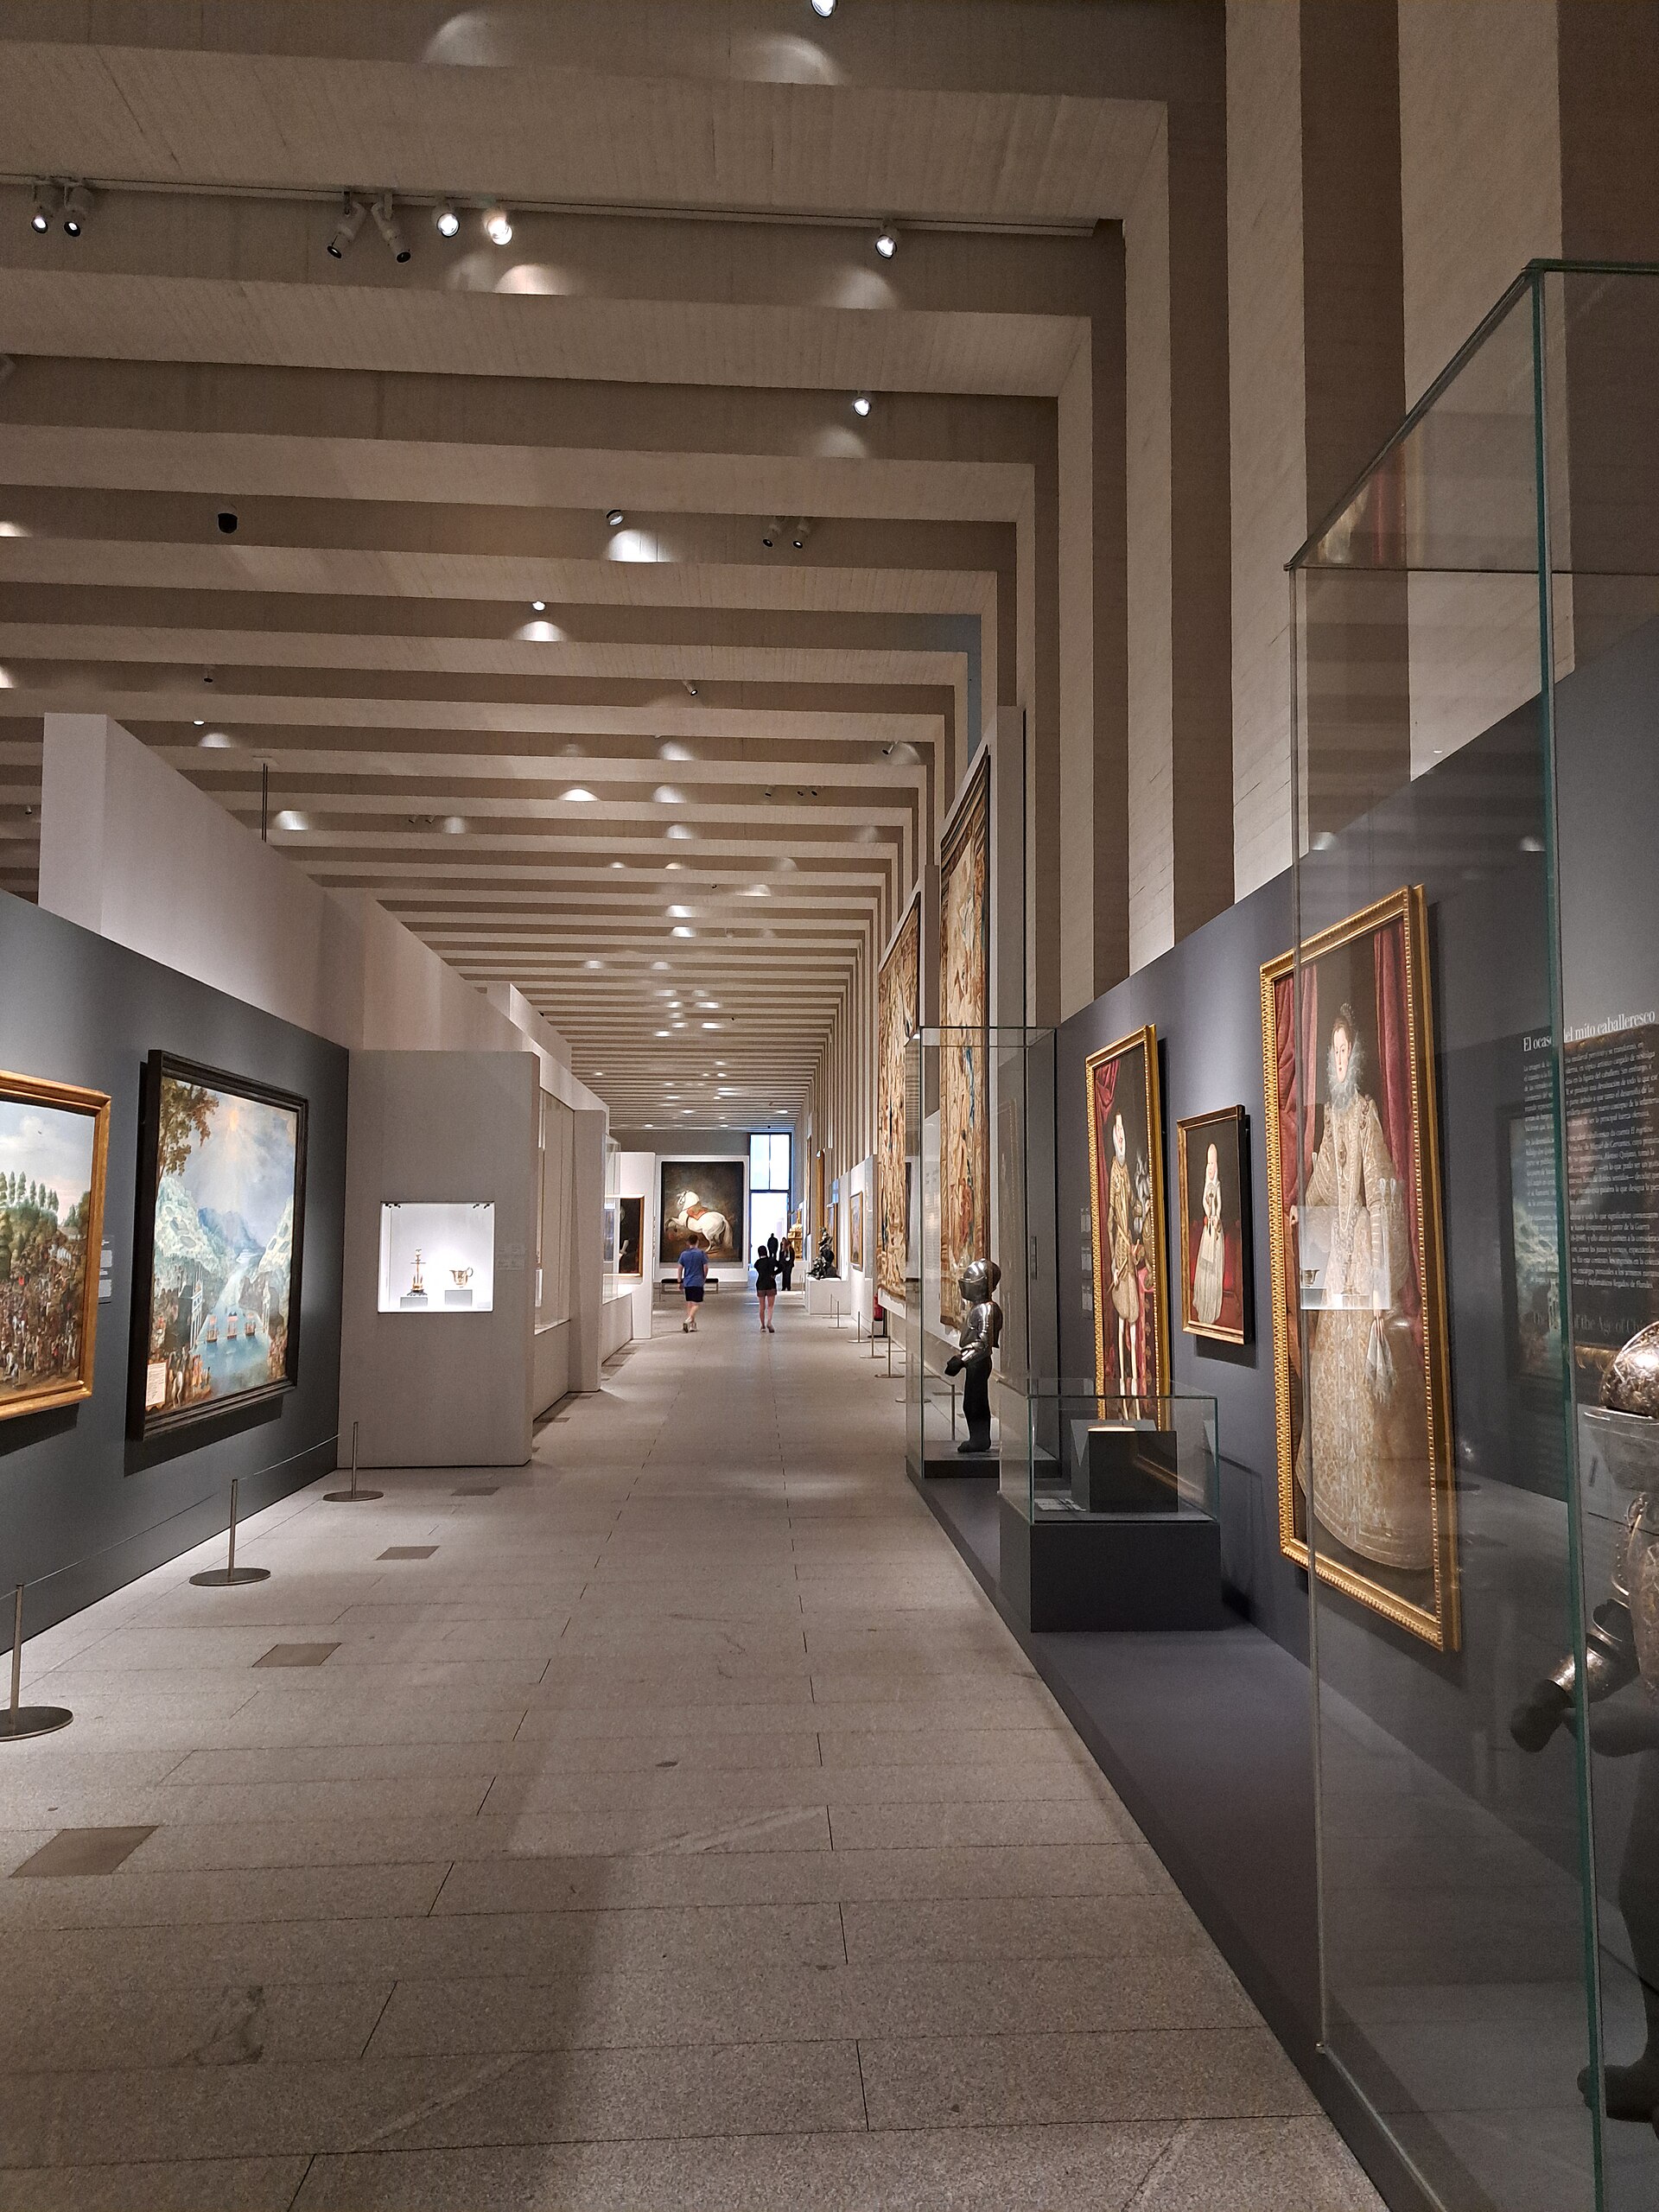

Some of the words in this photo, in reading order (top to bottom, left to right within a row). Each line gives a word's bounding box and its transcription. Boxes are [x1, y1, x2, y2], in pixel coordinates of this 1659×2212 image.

[1523, 1036, 1531, 1052] El
[1575, 1023, 1596, 1040] mito
[1597, 1011, 1656, 1035] caballeresco
